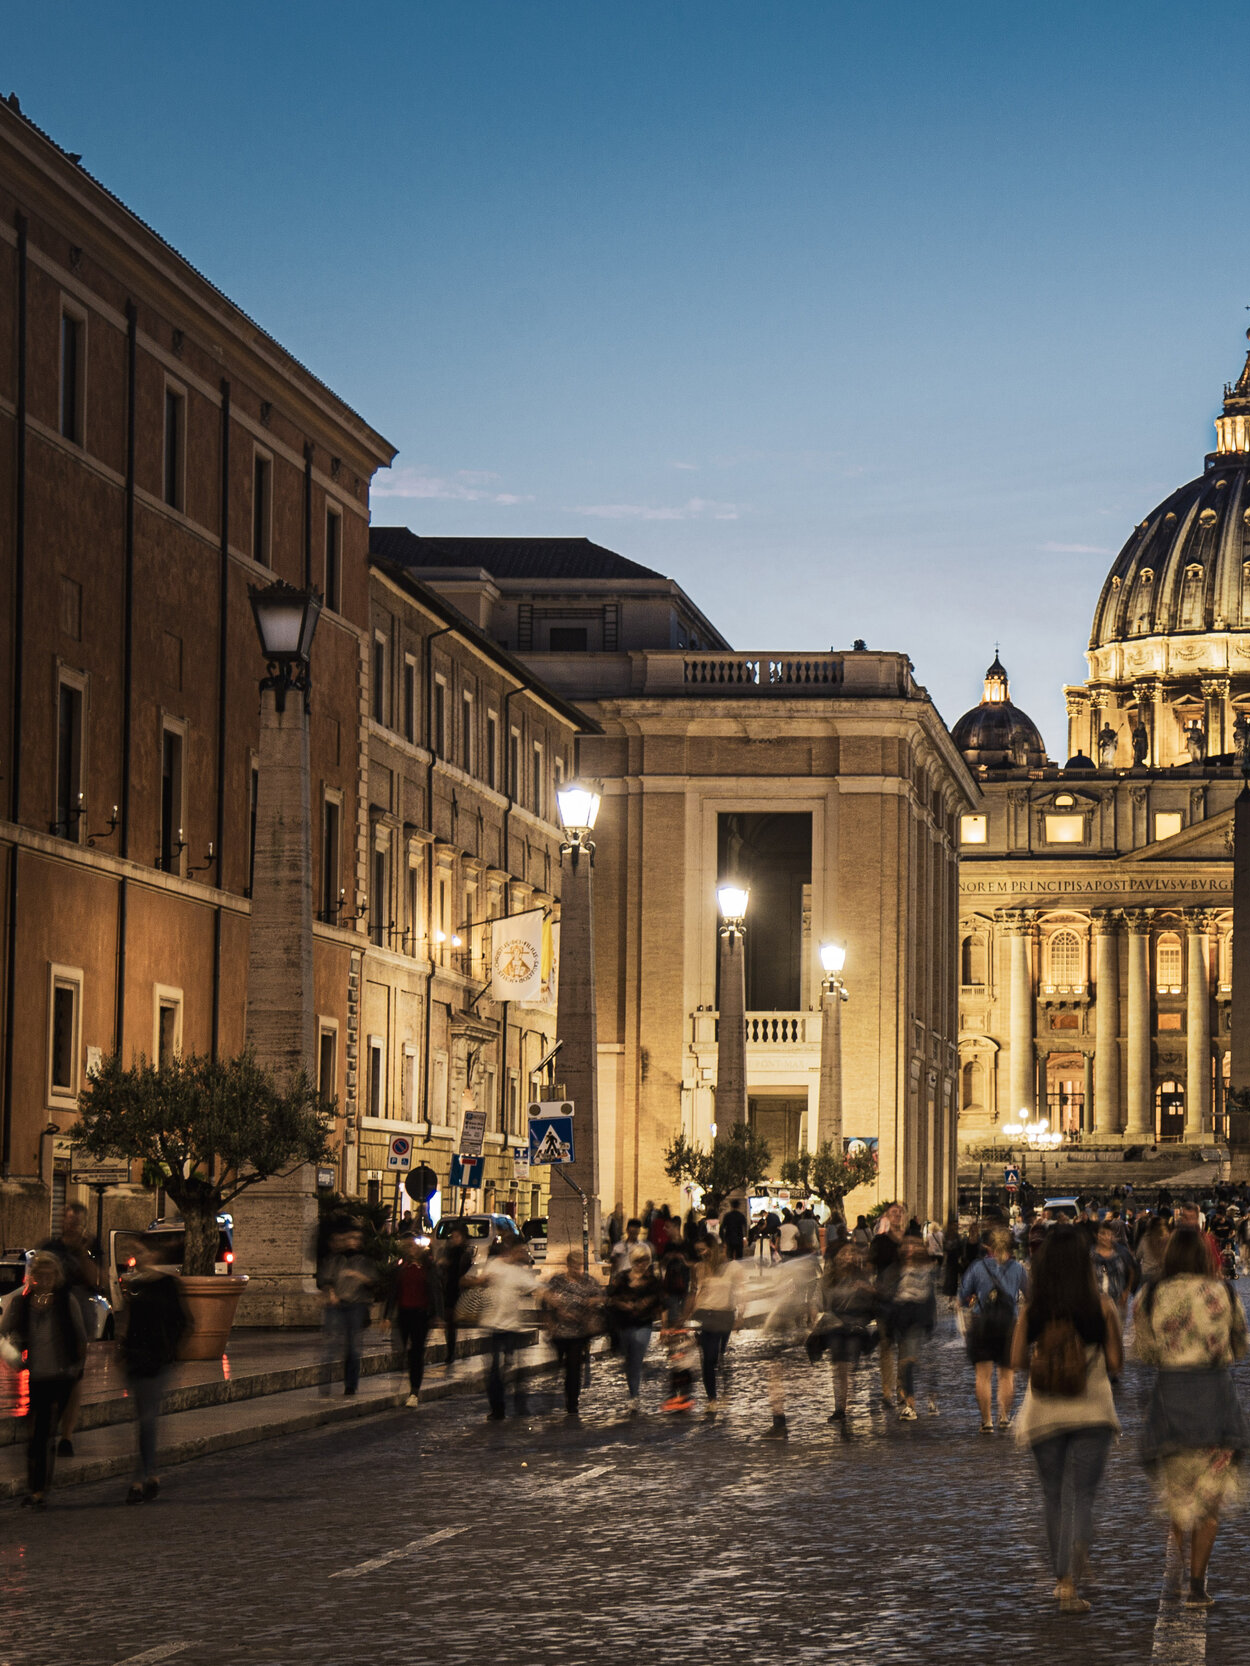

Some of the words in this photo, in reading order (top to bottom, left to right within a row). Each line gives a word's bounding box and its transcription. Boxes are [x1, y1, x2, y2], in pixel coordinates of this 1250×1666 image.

[958, 881, 1007, 892] NOREM
[1011, 880, 1083, 892] PRINCIPIS
[1084, 880, 1129, 891] APOST
[1129, 879, 1177, 890] PAVLVS
